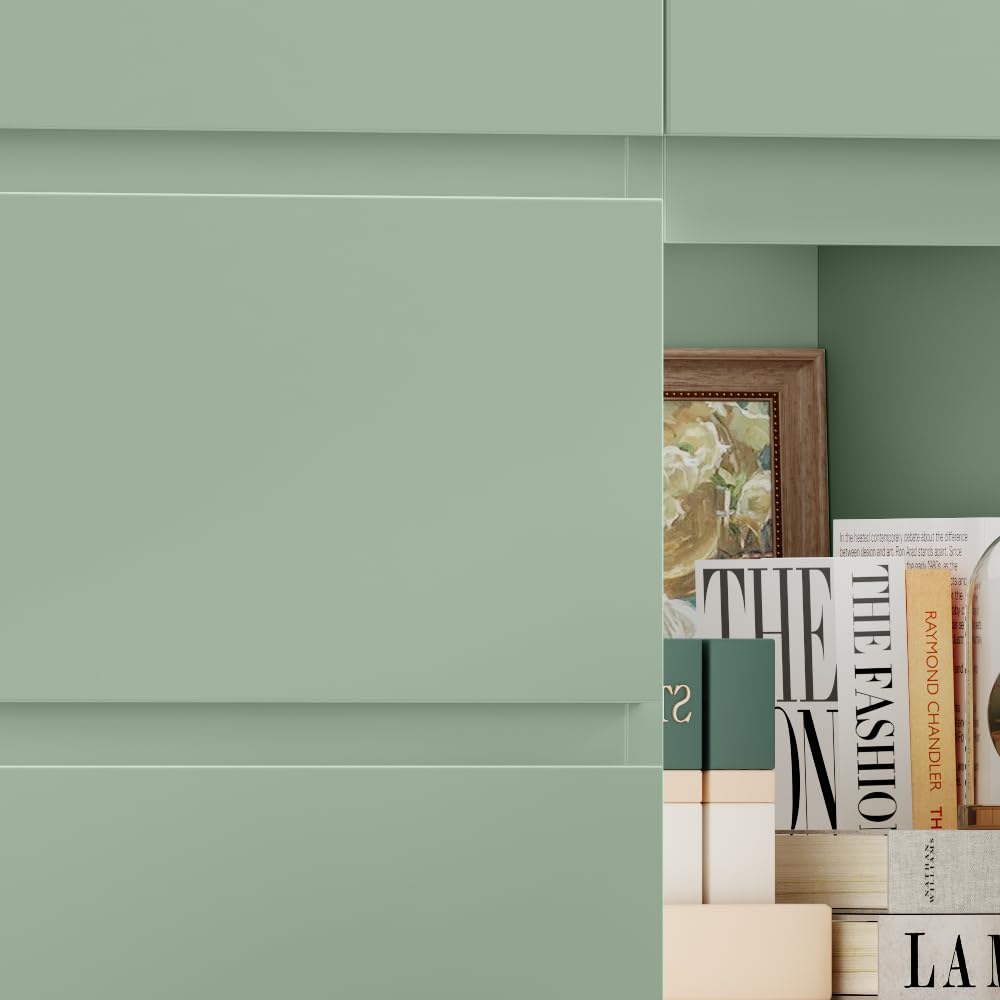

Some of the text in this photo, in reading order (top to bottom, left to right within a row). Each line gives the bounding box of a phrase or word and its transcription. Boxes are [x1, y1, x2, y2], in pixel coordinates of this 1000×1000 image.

[702, 567, 839, 702] THE
[851, 565, 898, 830] THE FASHIO
[924, 610, 943, 830] RAYMOND CHANDLER TH
[904, 932, 976, 989] LA
